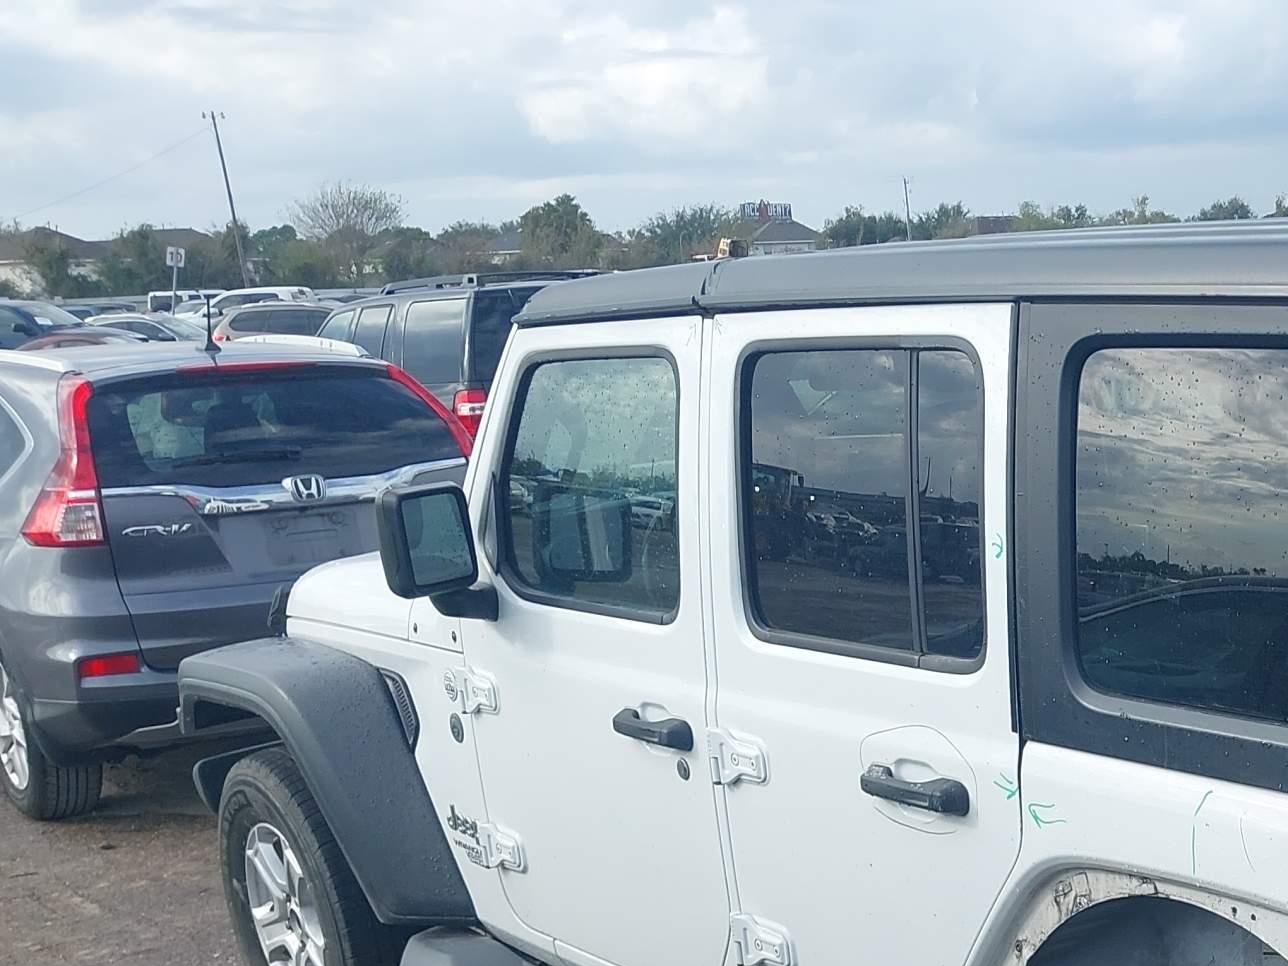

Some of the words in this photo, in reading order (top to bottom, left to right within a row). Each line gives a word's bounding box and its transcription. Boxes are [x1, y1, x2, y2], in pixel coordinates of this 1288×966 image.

[744, 203, 790, 216] ACCDENT?
[122, 523, 192, 536] CR-V
[447, 804, 480, 846] Jeep
